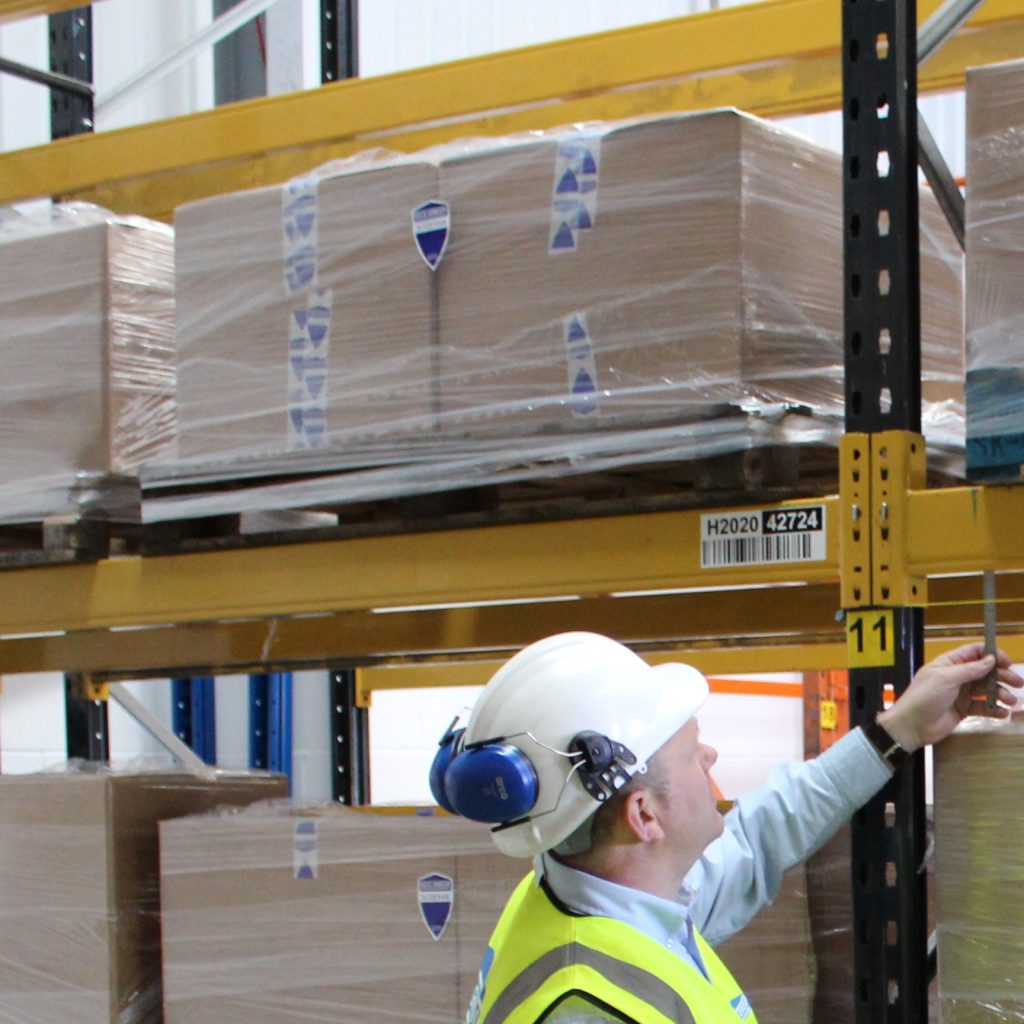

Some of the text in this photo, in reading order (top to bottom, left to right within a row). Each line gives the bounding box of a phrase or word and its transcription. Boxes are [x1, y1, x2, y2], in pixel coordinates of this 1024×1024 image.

[707, 510, 818, 535] H2020 42724
[850, 616, 886, 653] 11
